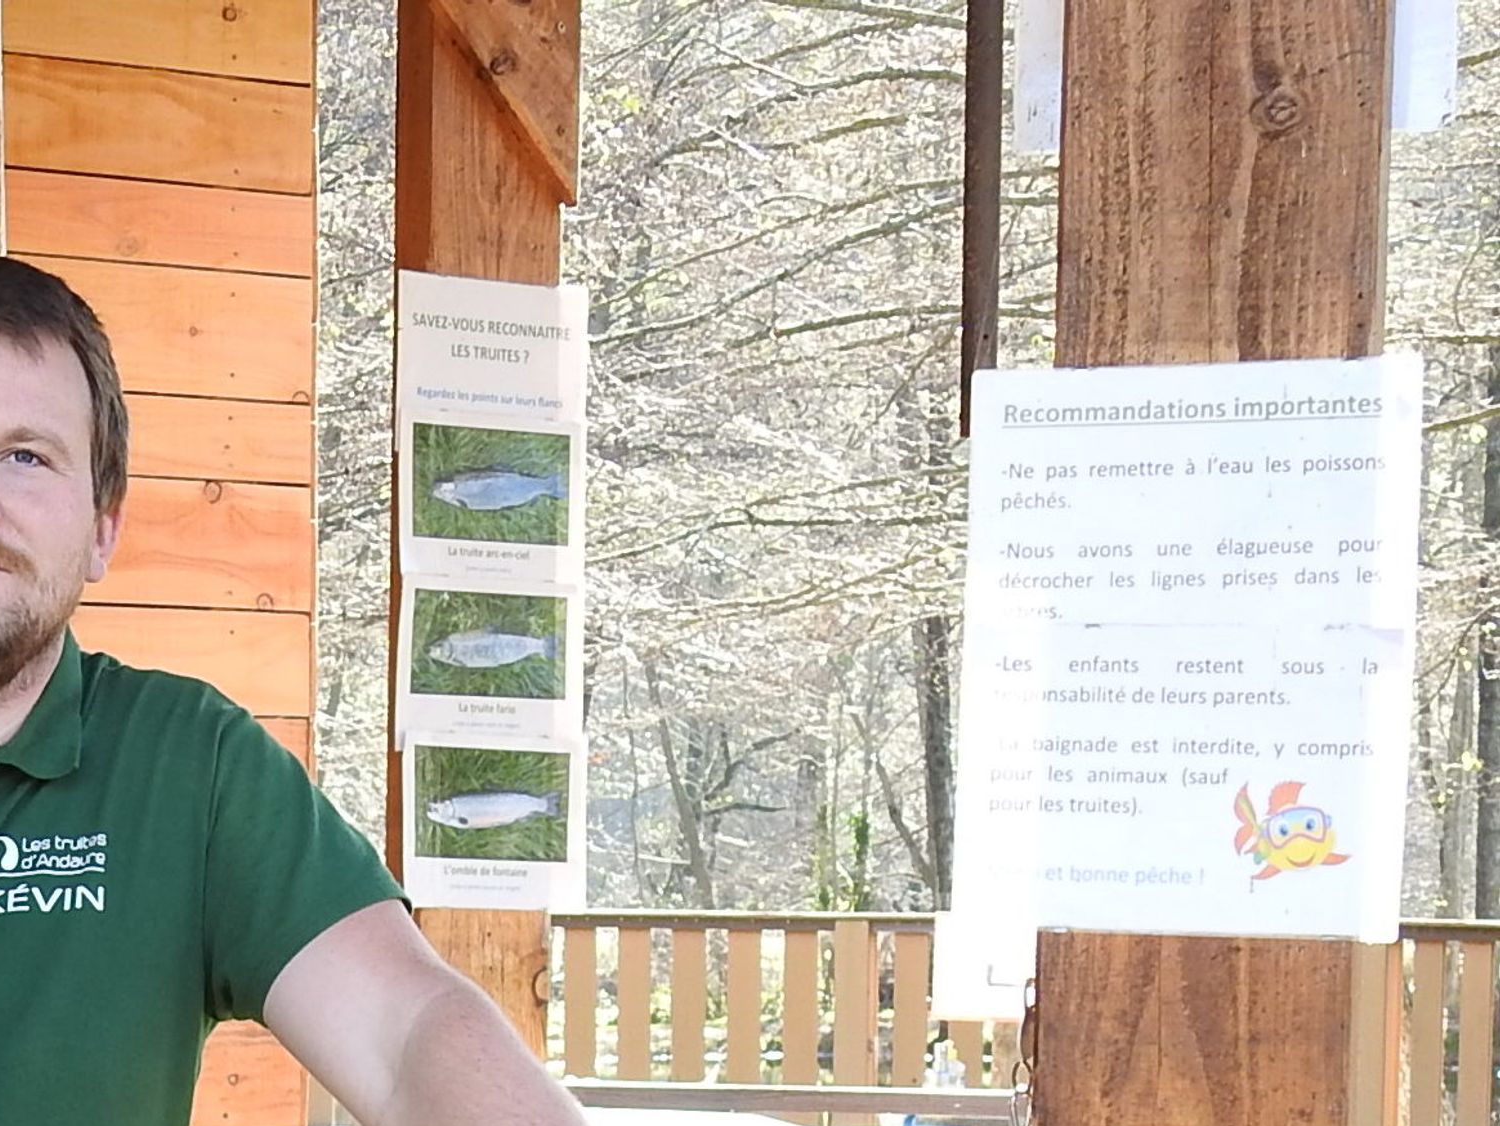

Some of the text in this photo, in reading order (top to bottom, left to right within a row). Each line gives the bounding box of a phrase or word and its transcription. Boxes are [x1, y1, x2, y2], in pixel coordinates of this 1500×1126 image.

[412, 312, 485, 334] SAVEZ-VOUS
[451, 344, 470, 358] LES
[474, 347, 520, 363] TRUITES
[1003, 395, 1383, 424] Recommandations importantes
[1046, 466, 1078, 482] pas
[1089, 461, 1174, 479] remettre
[1185, 458, 1196, 476] à
[1207, 456, 1253, 475] l'eau
[1265, 455, 1292, 474] les
[1303, 453, 1386, 476] poissons
[1000, 492, 1071, 513] pêchés.
[448, 546, 458, 556] La
[460, 546, 483, 559] truite
[1000, 537, 1382, 560] -Nous avons une élagueuse pour
[998, 572, 1093, 590] décrocher
[1109, 570, 1135, 588] les
[1151, 570, 1206, 591] lignes
[1222, 569, 1278, 589] prises
[1294, 567, 1340, 586] dans
[995, 657, 1378, 676] -Les enfants restent sous la
[1131, 686, 1155, 705] de
[1160, 687, 1208, 705] leurs
[1213, 689, 1291, 708] parents.
[458, 702, 469, 713] La
[470, 702, 494, 715] truite
[1130, 740, 1159, 754] est
[1172, 738, 1261, 759] interdite,
[1273, 743, 1285, 760] y
[1297, 741, 1375, 761] compris
[1047, 765, 1074, 784] les
[1087, 768, 1168, 785] animaux
[1181, 766, 1229, 788] (sauf
[1038, 795, 1064, 812] les
[1070, 796, 1143, 817] truites).
[22, 837, 51, 853] Les
[21, 852, 106, 870] d'Andaure
[1044, 867, 1063, 882] et
[1069, 866, 1129, 883] bonne
[1134, 866, 1193, 887] pêche
